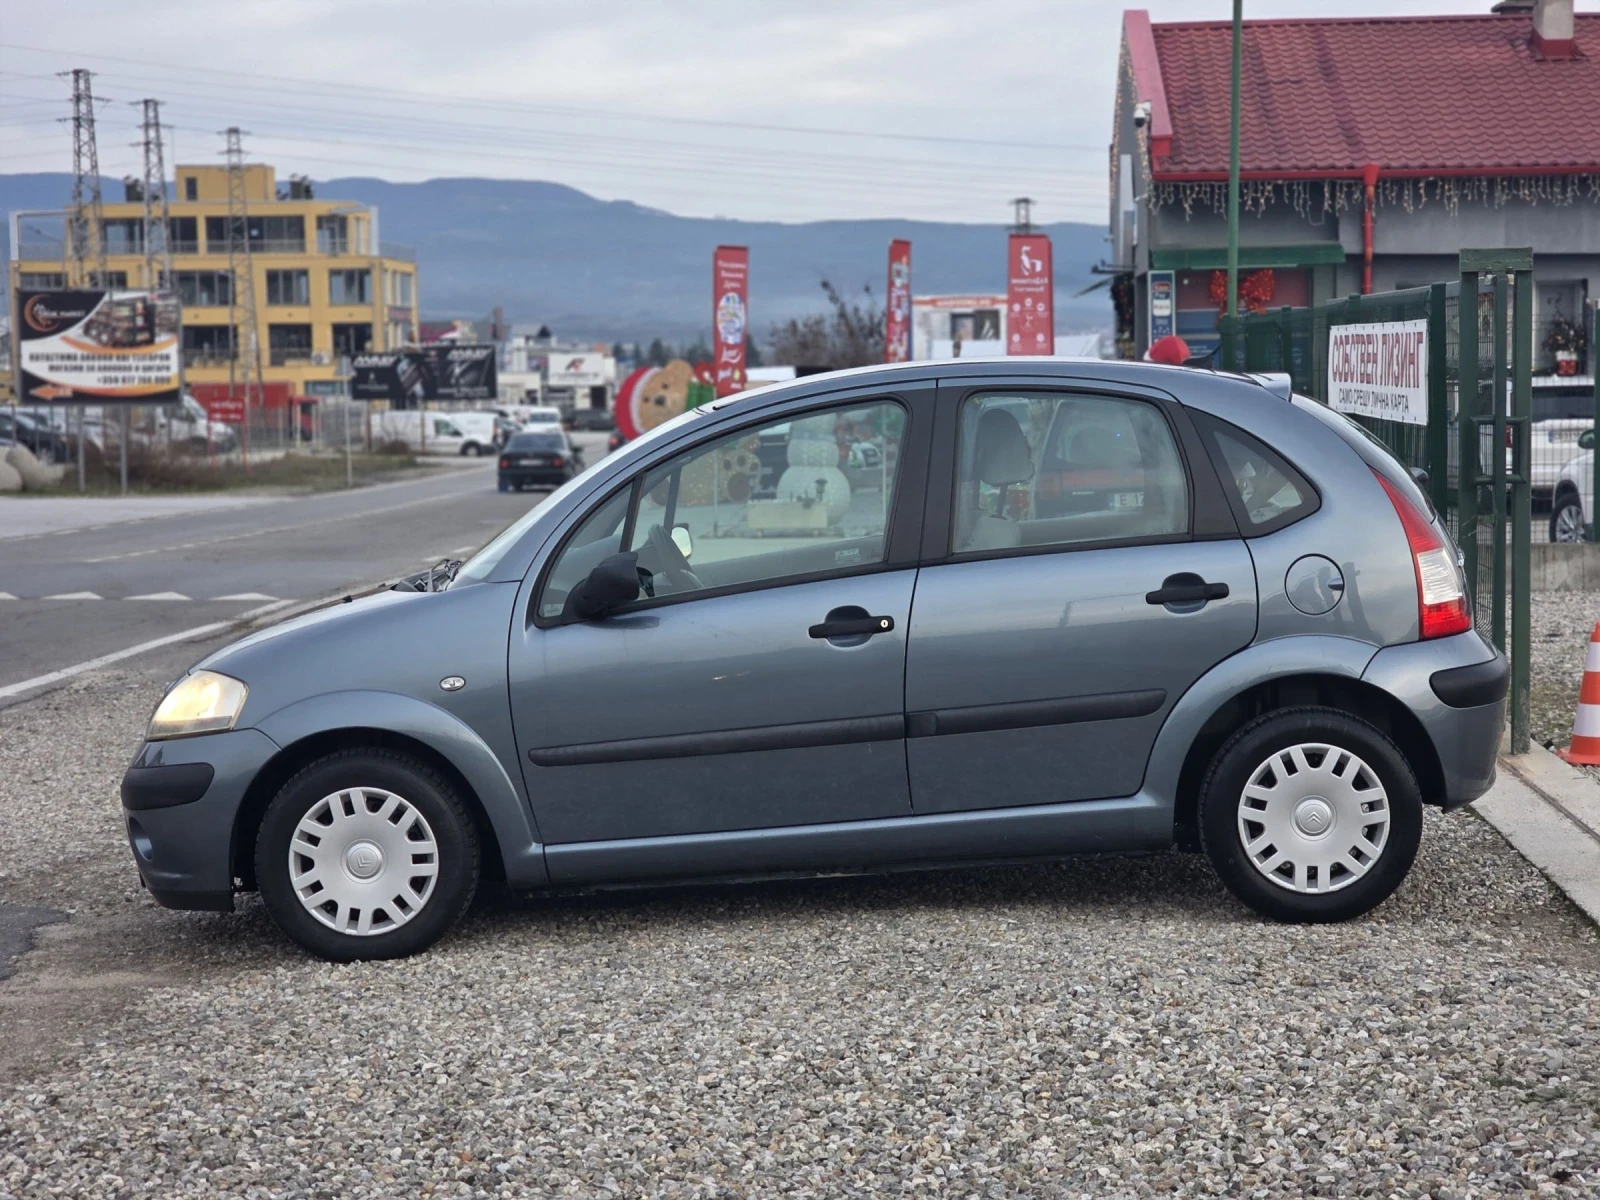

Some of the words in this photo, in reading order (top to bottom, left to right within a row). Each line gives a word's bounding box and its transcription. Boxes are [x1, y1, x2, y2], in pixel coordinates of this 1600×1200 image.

[1331, 333, 1379, 386] СОБСТВЕН
[1379, 331, 1424, 389] ЛИЗИНГ
[1338, 387, 1353, 405] САМО
[1353, 388, 1371, 407] СРЕЩУ
[1370, 389, 1390, 411] ЛИЧНА
[1390, 392, 1410, 413] КАРТА
